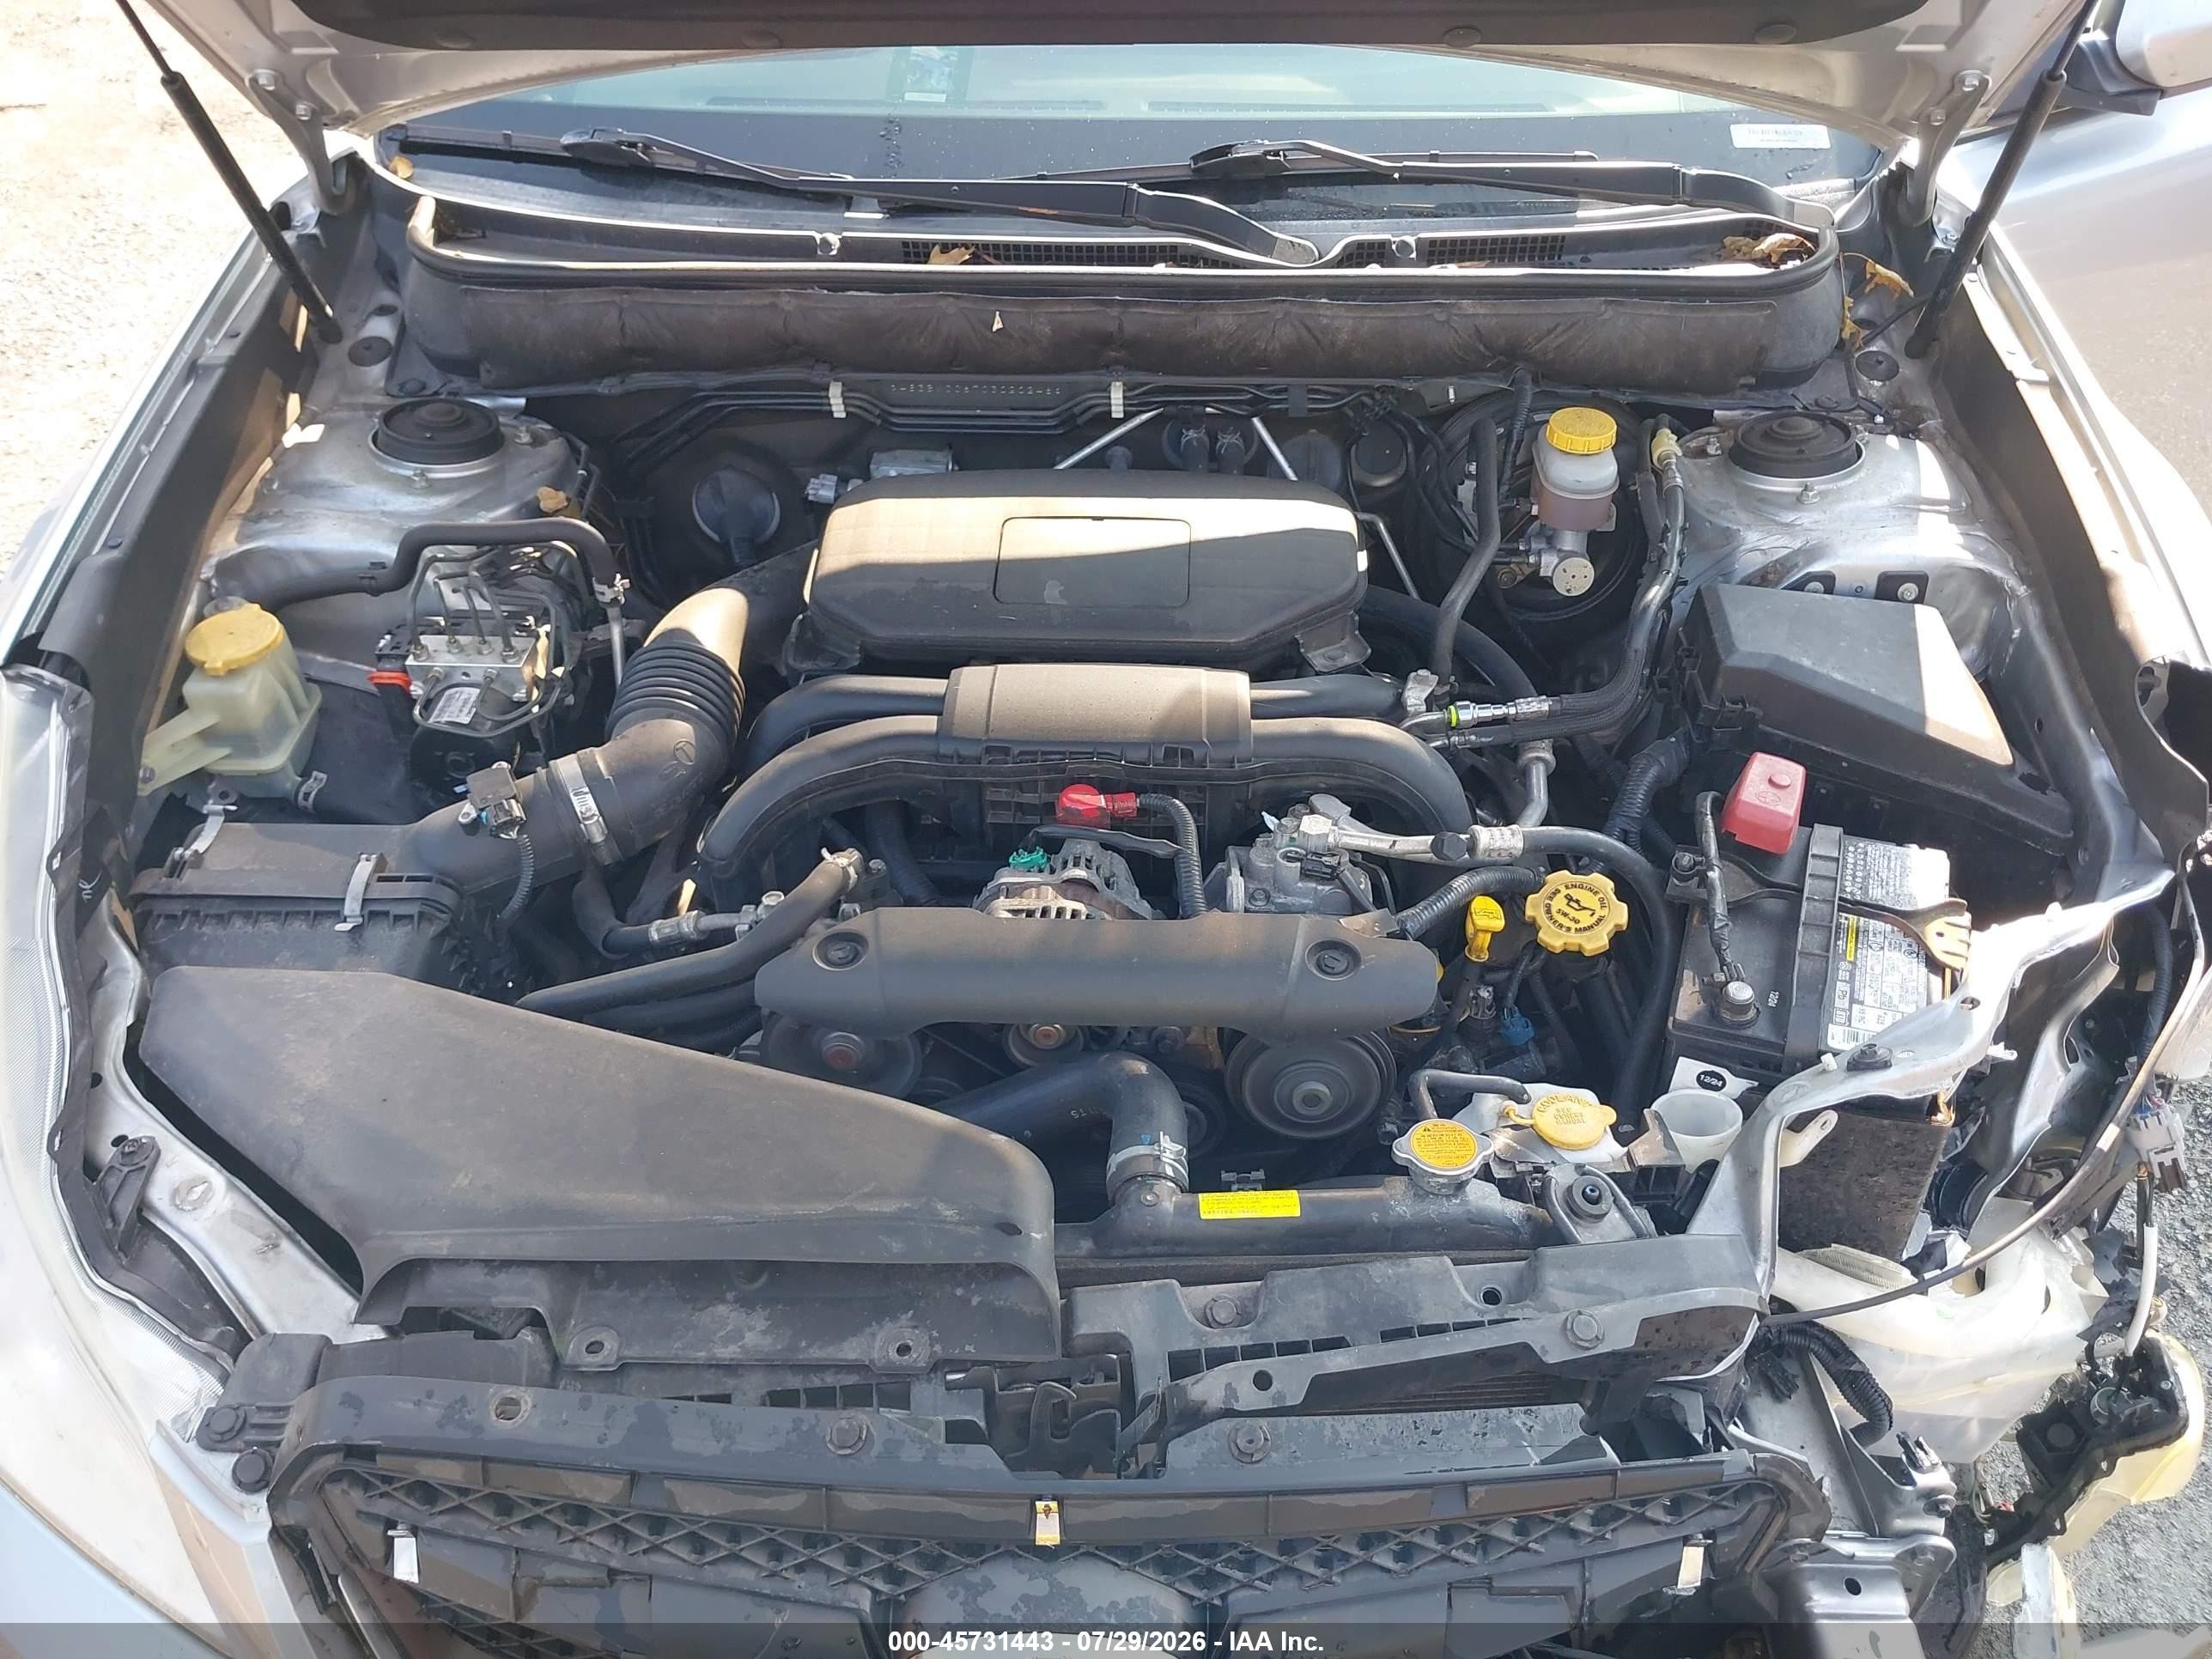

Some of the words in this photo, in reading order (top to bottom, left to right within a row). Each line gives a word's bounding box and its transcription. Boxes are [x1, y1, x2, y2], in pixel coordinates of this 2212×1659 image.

[1547, 888, 1561, 902] SEE
[1565, 883, 1598, 896] ENGINE
[1597, 896, 1607, 910] OIL
[1545, 902, 1572, 933] OWNER'S
[1556, 908, 1581, 925] 5W-30
[1574, 914, 1606, 933] MANUAL
